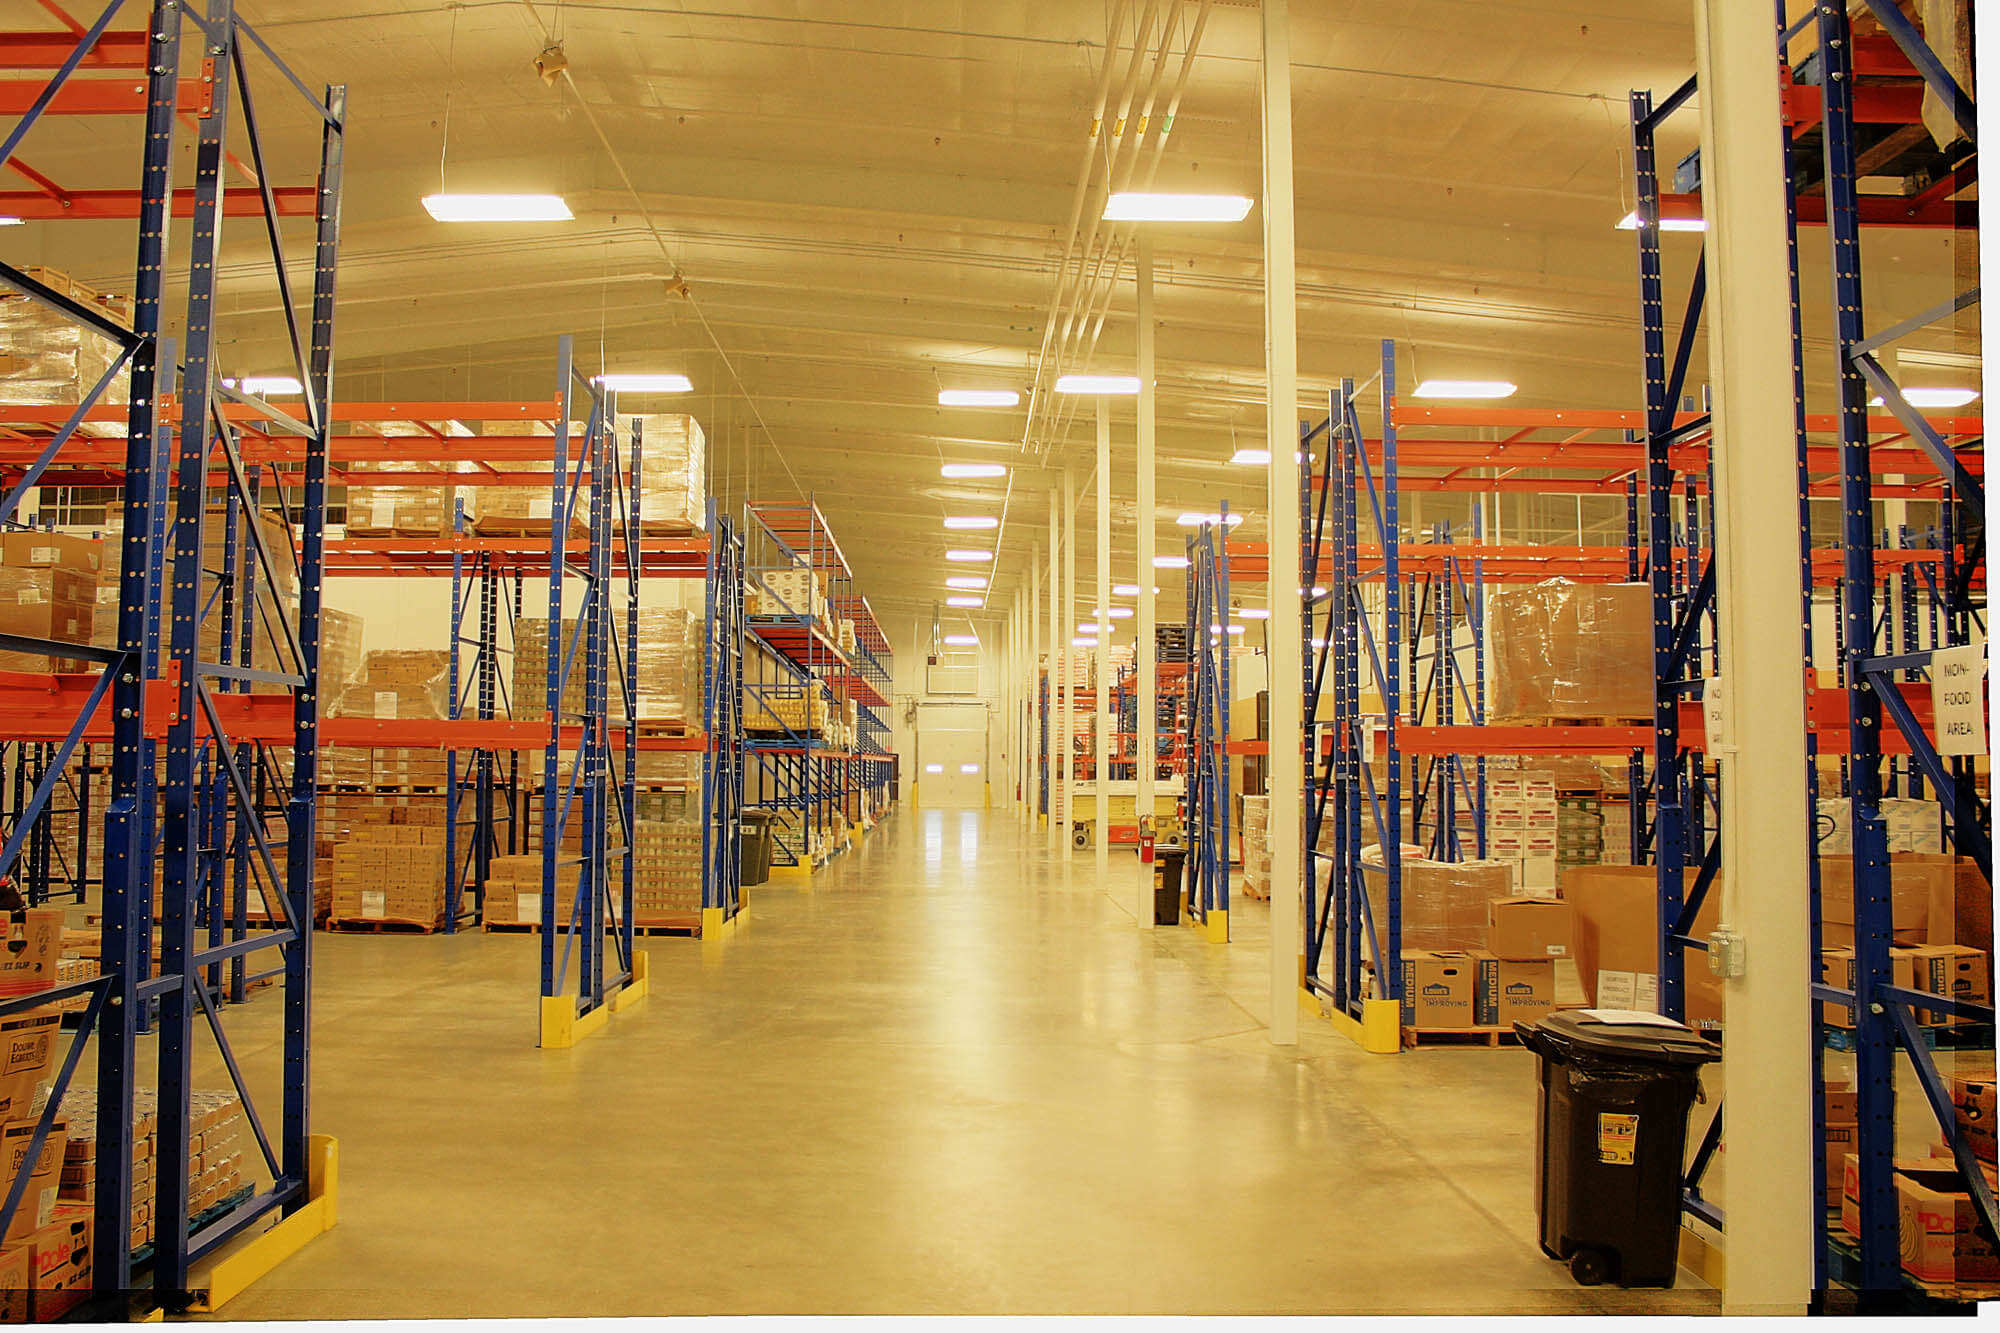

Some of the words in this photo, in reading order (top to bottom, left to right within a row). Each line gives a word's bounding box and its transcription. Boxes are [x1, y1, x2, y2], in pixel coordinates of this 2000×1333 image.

[1943, 663, 1970, 677] NON-
[1943, 691, 1971, 706] FOOD
[1947, 721, 1974, 735] AREA
[1406, 962, 1414, 1008] MEDIUM
[1488, 961, 1497, 1007] MEDIUM
[1937, 959, 1945, 995] MEDIU
